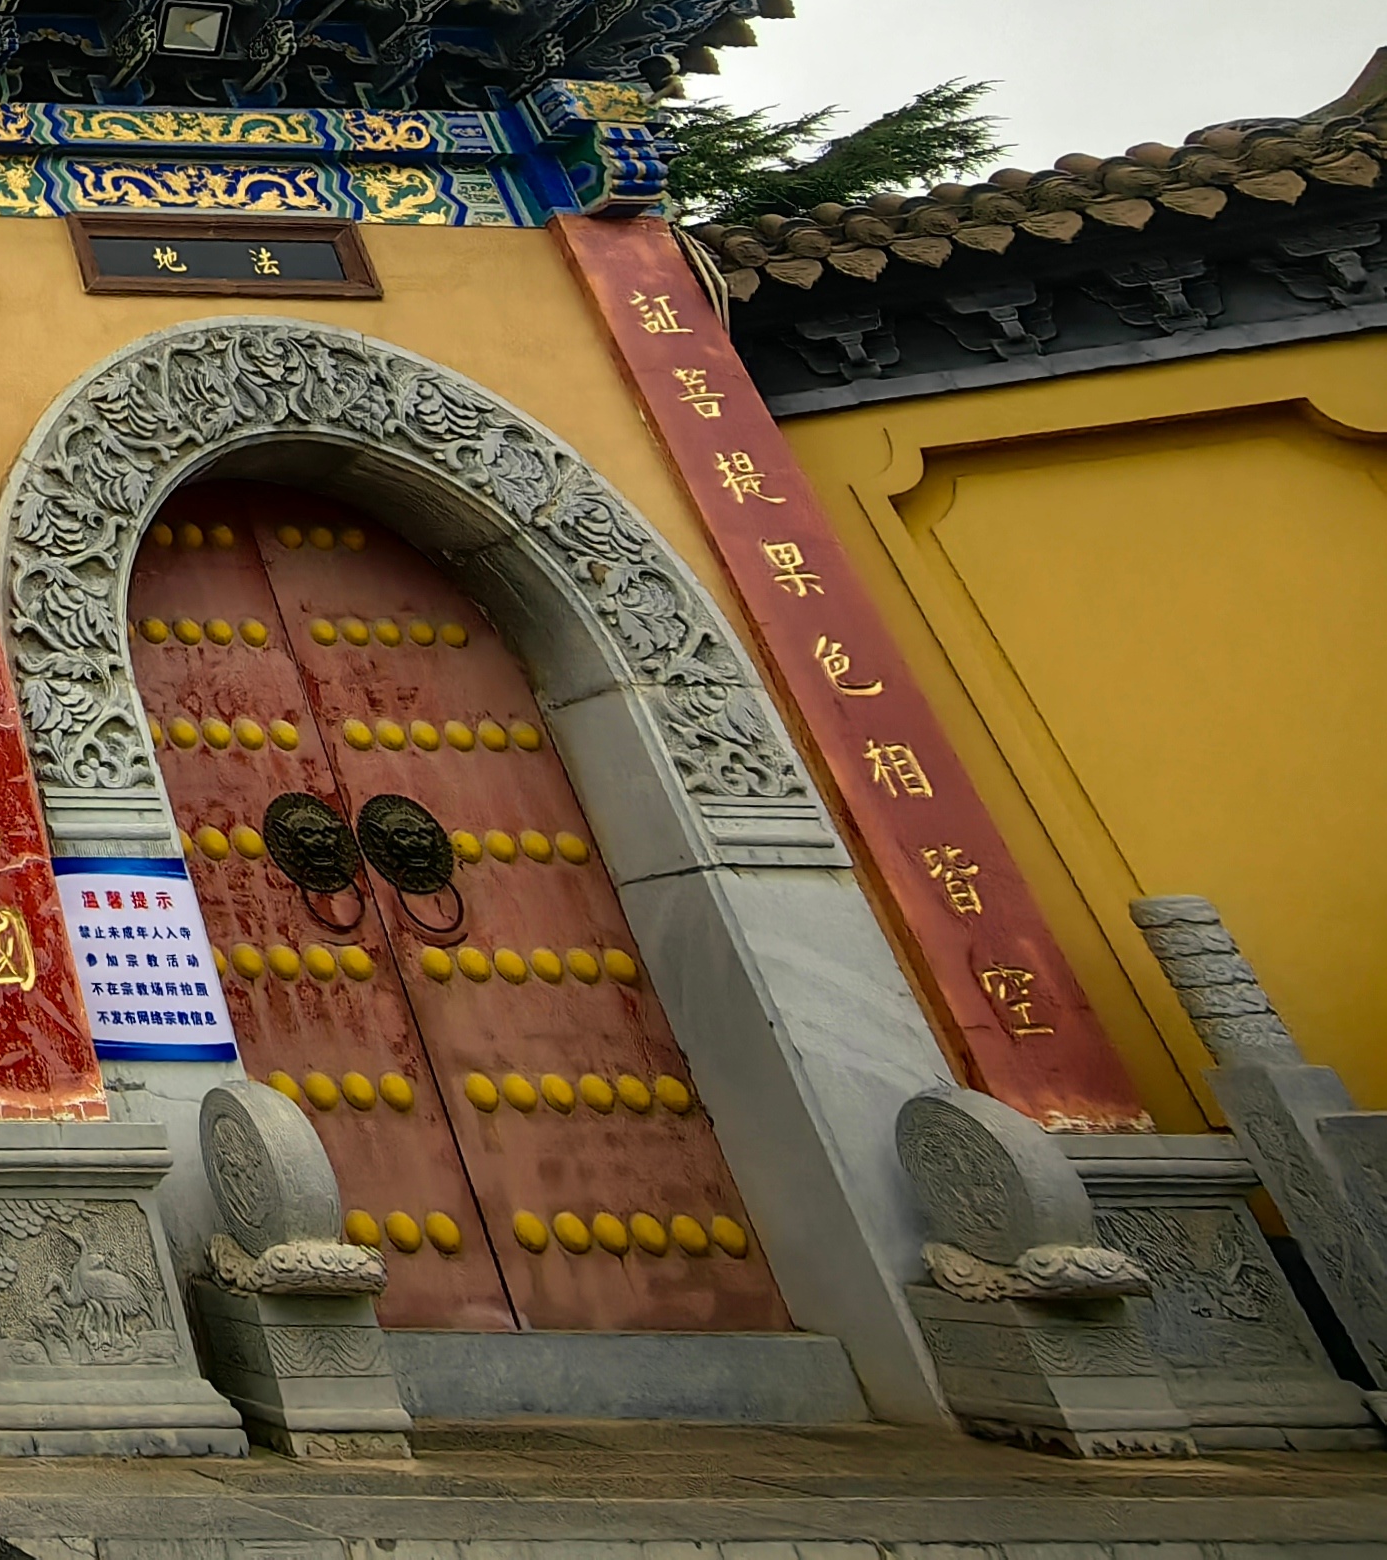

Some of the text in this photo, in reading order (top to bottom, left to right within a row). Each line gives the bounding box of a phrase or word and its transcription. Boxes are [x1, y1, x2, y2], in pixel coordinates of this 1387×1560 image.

[81, 890, 174, 910] 温馨提示
[78, 925, 192, 940] 禁止未成年人入寺
[91, 982, 210, 997] 不在宗教场所拍照
[97, 1011, 218, 1026] 不发布网络宗教信息
